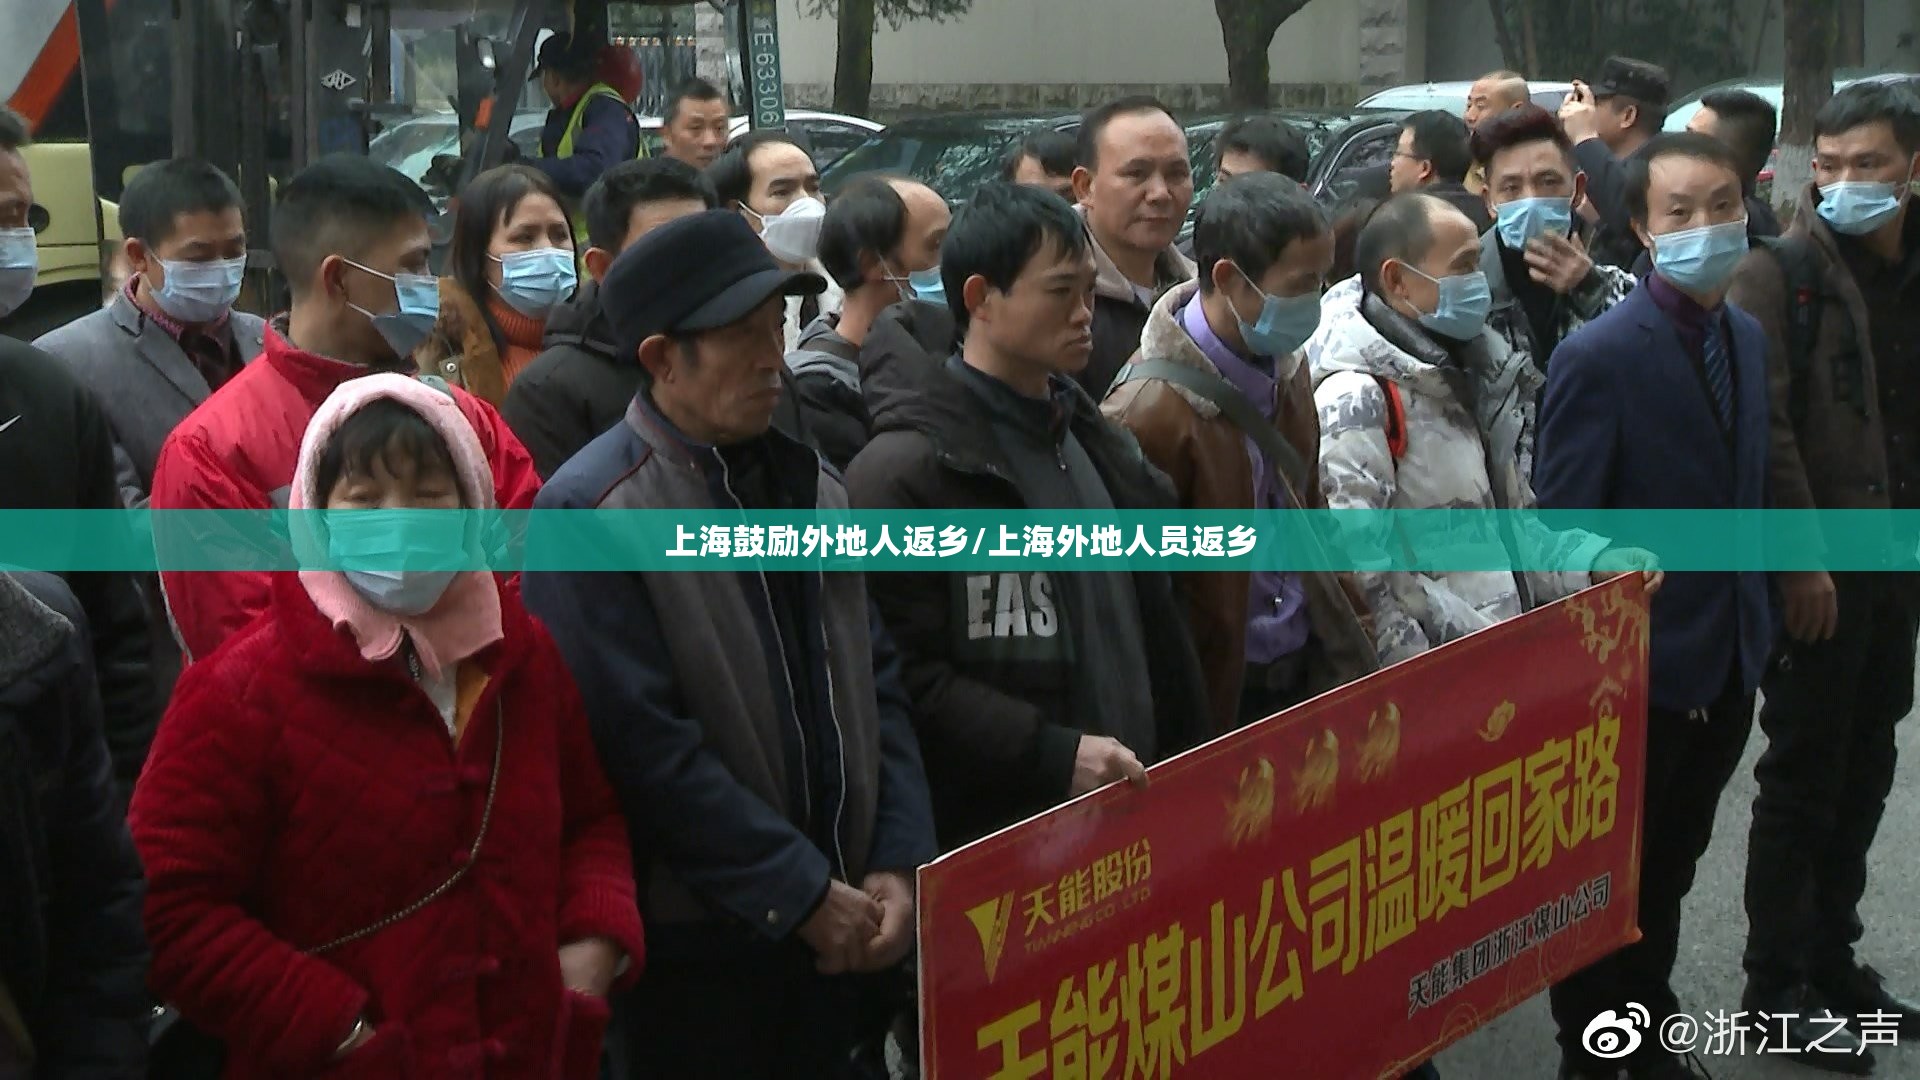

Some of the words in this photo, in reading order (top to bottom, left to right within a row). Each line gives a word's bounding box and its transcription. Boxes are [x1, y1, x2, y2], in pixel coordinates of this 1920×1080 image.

[1022, 837, 1152, 937] 天能股份
[1408, 871, 1612, 1020] 天能集团浙江煤山公司
